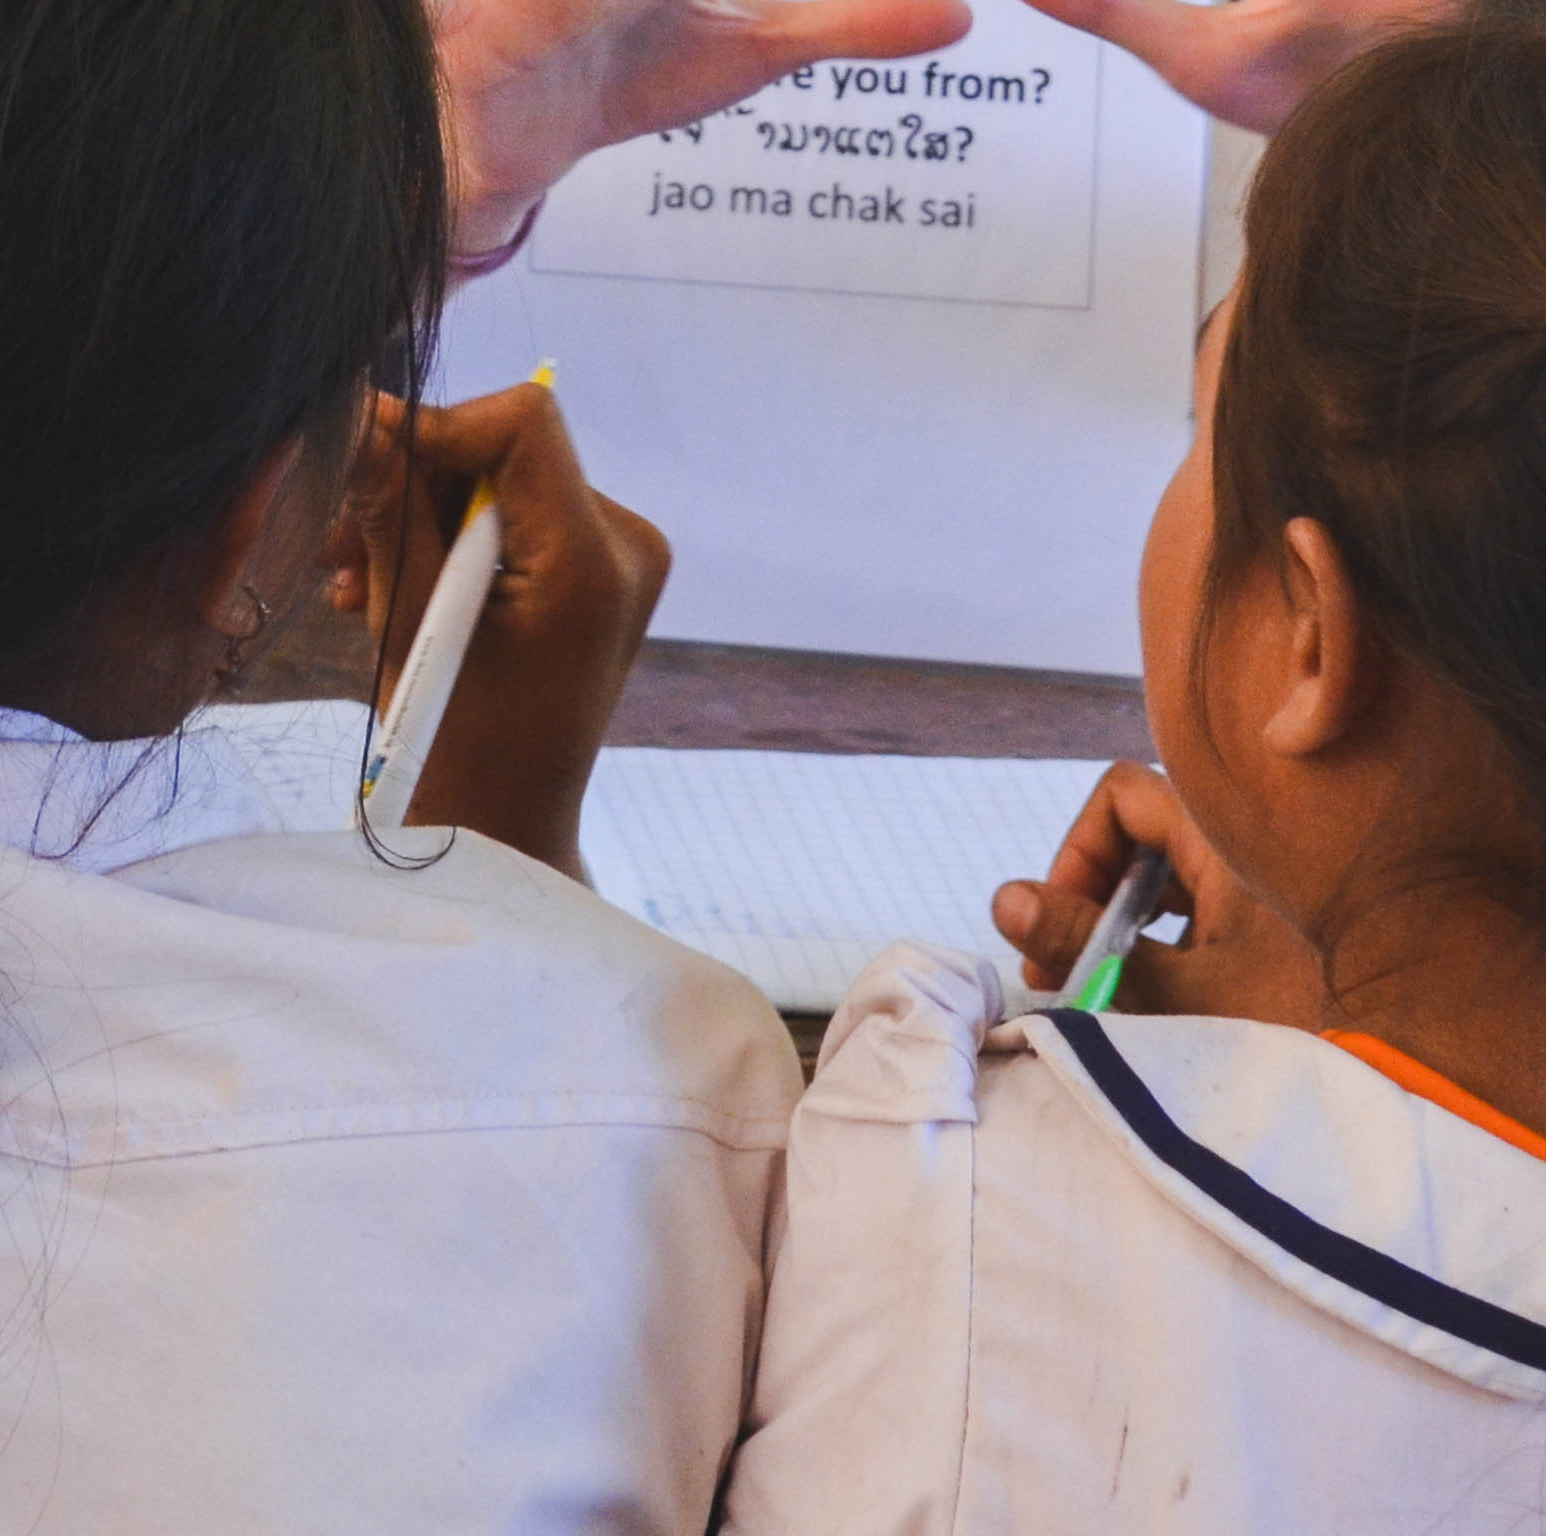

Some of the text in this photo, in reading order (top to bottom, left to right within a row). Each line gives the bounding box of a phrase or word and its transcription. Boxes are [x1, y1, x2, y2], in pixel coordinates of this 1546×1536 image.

[831, 67, 906, 100] you
[924, 61, 1051, 104] from?
[648, 174, 976, 228] jao ma chak sai
